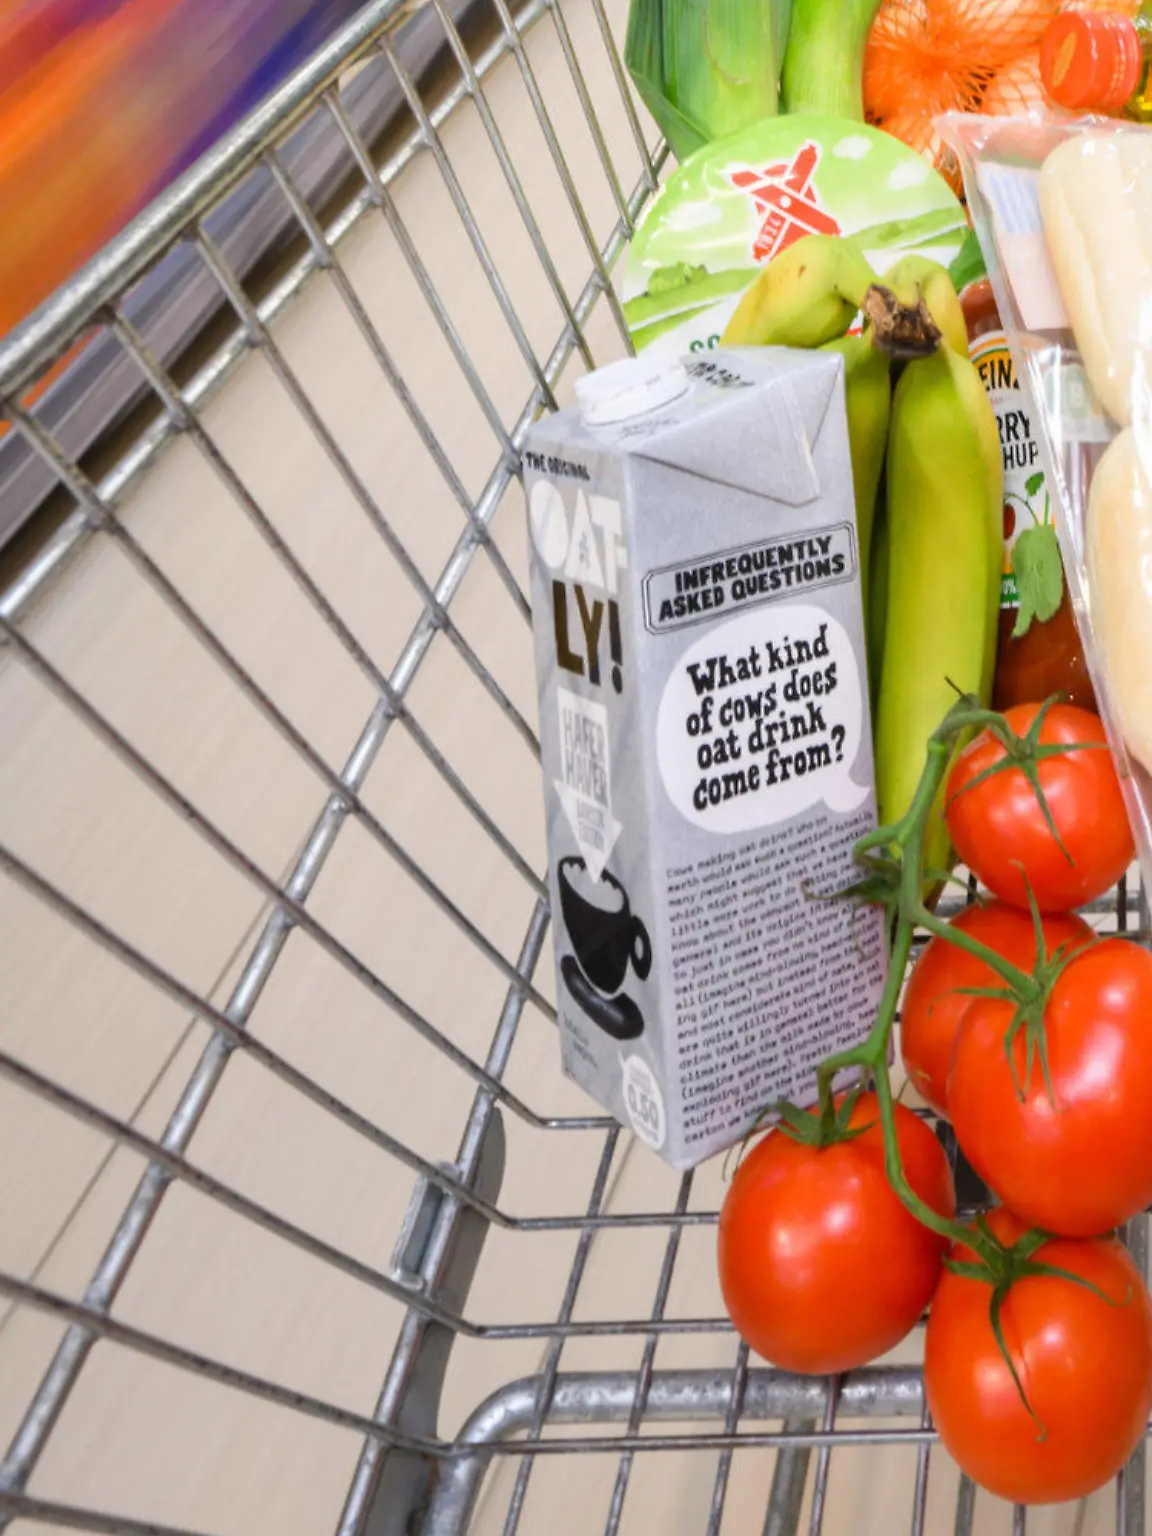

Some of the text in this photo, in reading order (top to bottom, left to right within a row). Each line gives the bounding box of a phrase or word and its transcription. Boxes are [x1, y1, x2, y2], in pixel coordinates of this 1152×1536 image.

[978, 358, 1020, 392] EIN
[525, 452, 546, 473] THE
[659, 554, 845, 622] ASKED QUESTIONS
[675, 535, 832, 593] INFREQUENTLY
[552, 579, 623, 695] LY!
[686, 623, 830, 696] What kind
[686, 662, 838, 737] of cows does
[697, 701, 827, 770] oat drink
[693, 724, 846, 811] come from?
[679, 1049, 711, 1070] drink
[716, 1039, 739, 1056] that
[760, 1027, 771, 1038] in
[680, 1061, 726, 1085] climate
[731, 1048, 755, 1065] than
[760, 1039, 776, 1053] the
[681, 1072, 734, 1100] (imagine
[682, 1085, 740, 1114] exploding
[743, 1074, 759, 1092] gif
[683, 1107, 715, 1129] stuff
[719, 1103, 731, 1114] to
[735, 1089, 758, 1108] find
[776, 1076, 791, 1089] the
[685, 1122, 724, 1145] carton
